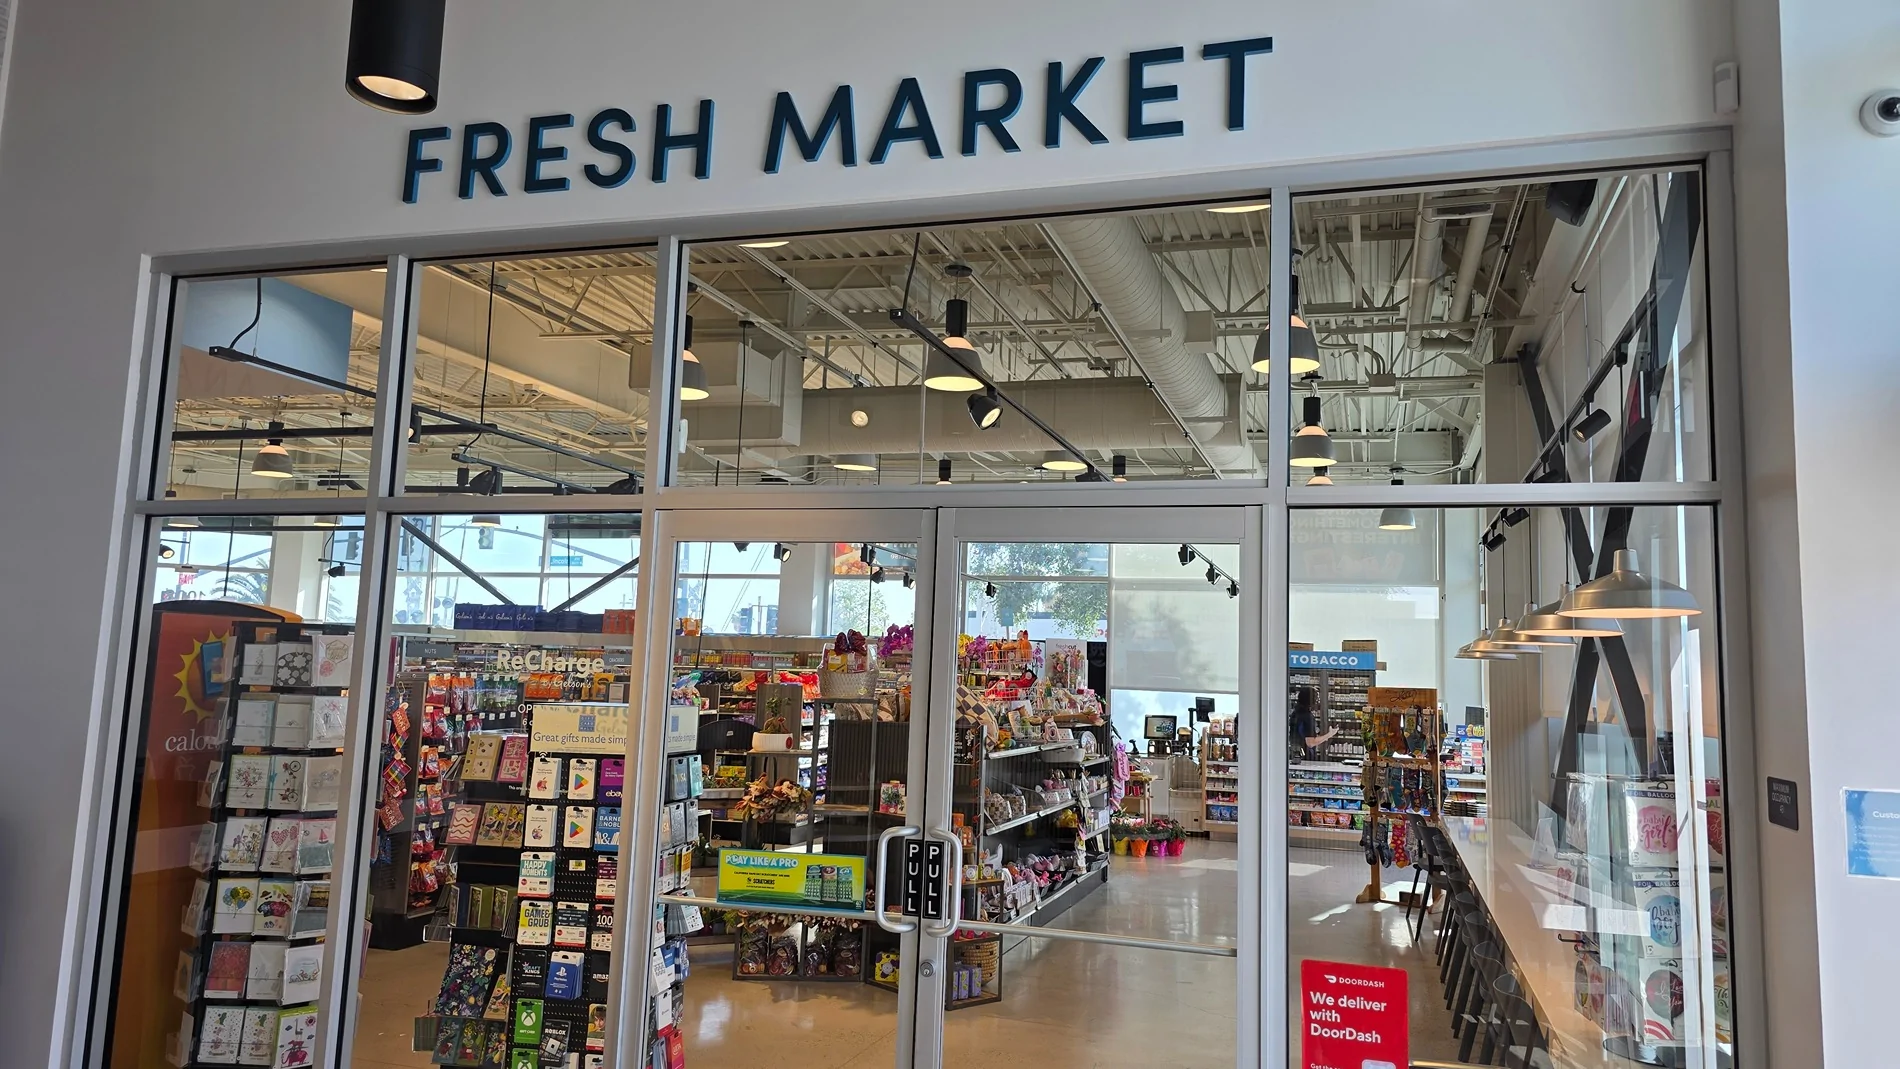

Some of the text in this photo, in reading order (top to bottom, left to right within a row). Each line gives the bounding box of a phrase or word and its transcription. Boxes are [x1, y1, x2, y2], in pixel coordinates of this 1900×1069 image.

[402, 37, 1273, 203] FRESH MARKET
[497, 649, 605, 679] ReCharge
[1290, 654, 1358, 666] TOBACCO
[553, 674, 592, 689] Gelson's
[518, 704, 533, 714] OP
[533, 732, 627, 746] Great gifts made simp
[1647, 791, 1675, 799] BALLOO
[1872, 810, 1900, 819] Custo
[1642, 815, 1671, 849] girl
[523, 860, 547, 870] HAPPY
[750, 856, 768, 866] LIKE
[770, 857, 778, 866] A
[780, 857, 799, 868] PRO
[522, 868, 548, 877] MOMENTS
[907, 844, 919, 912] PULL
[927, 847, 940, 915] PULL
[527, 918, 549, 927] GRUB
[1338, 977, 1385, 988] DOORDASH
[1310, 991, 1387, 1012] We deliver
[1310, 1009, 1341, 1023] with
[1310, 1023, 1381, 1043] DoorDash
